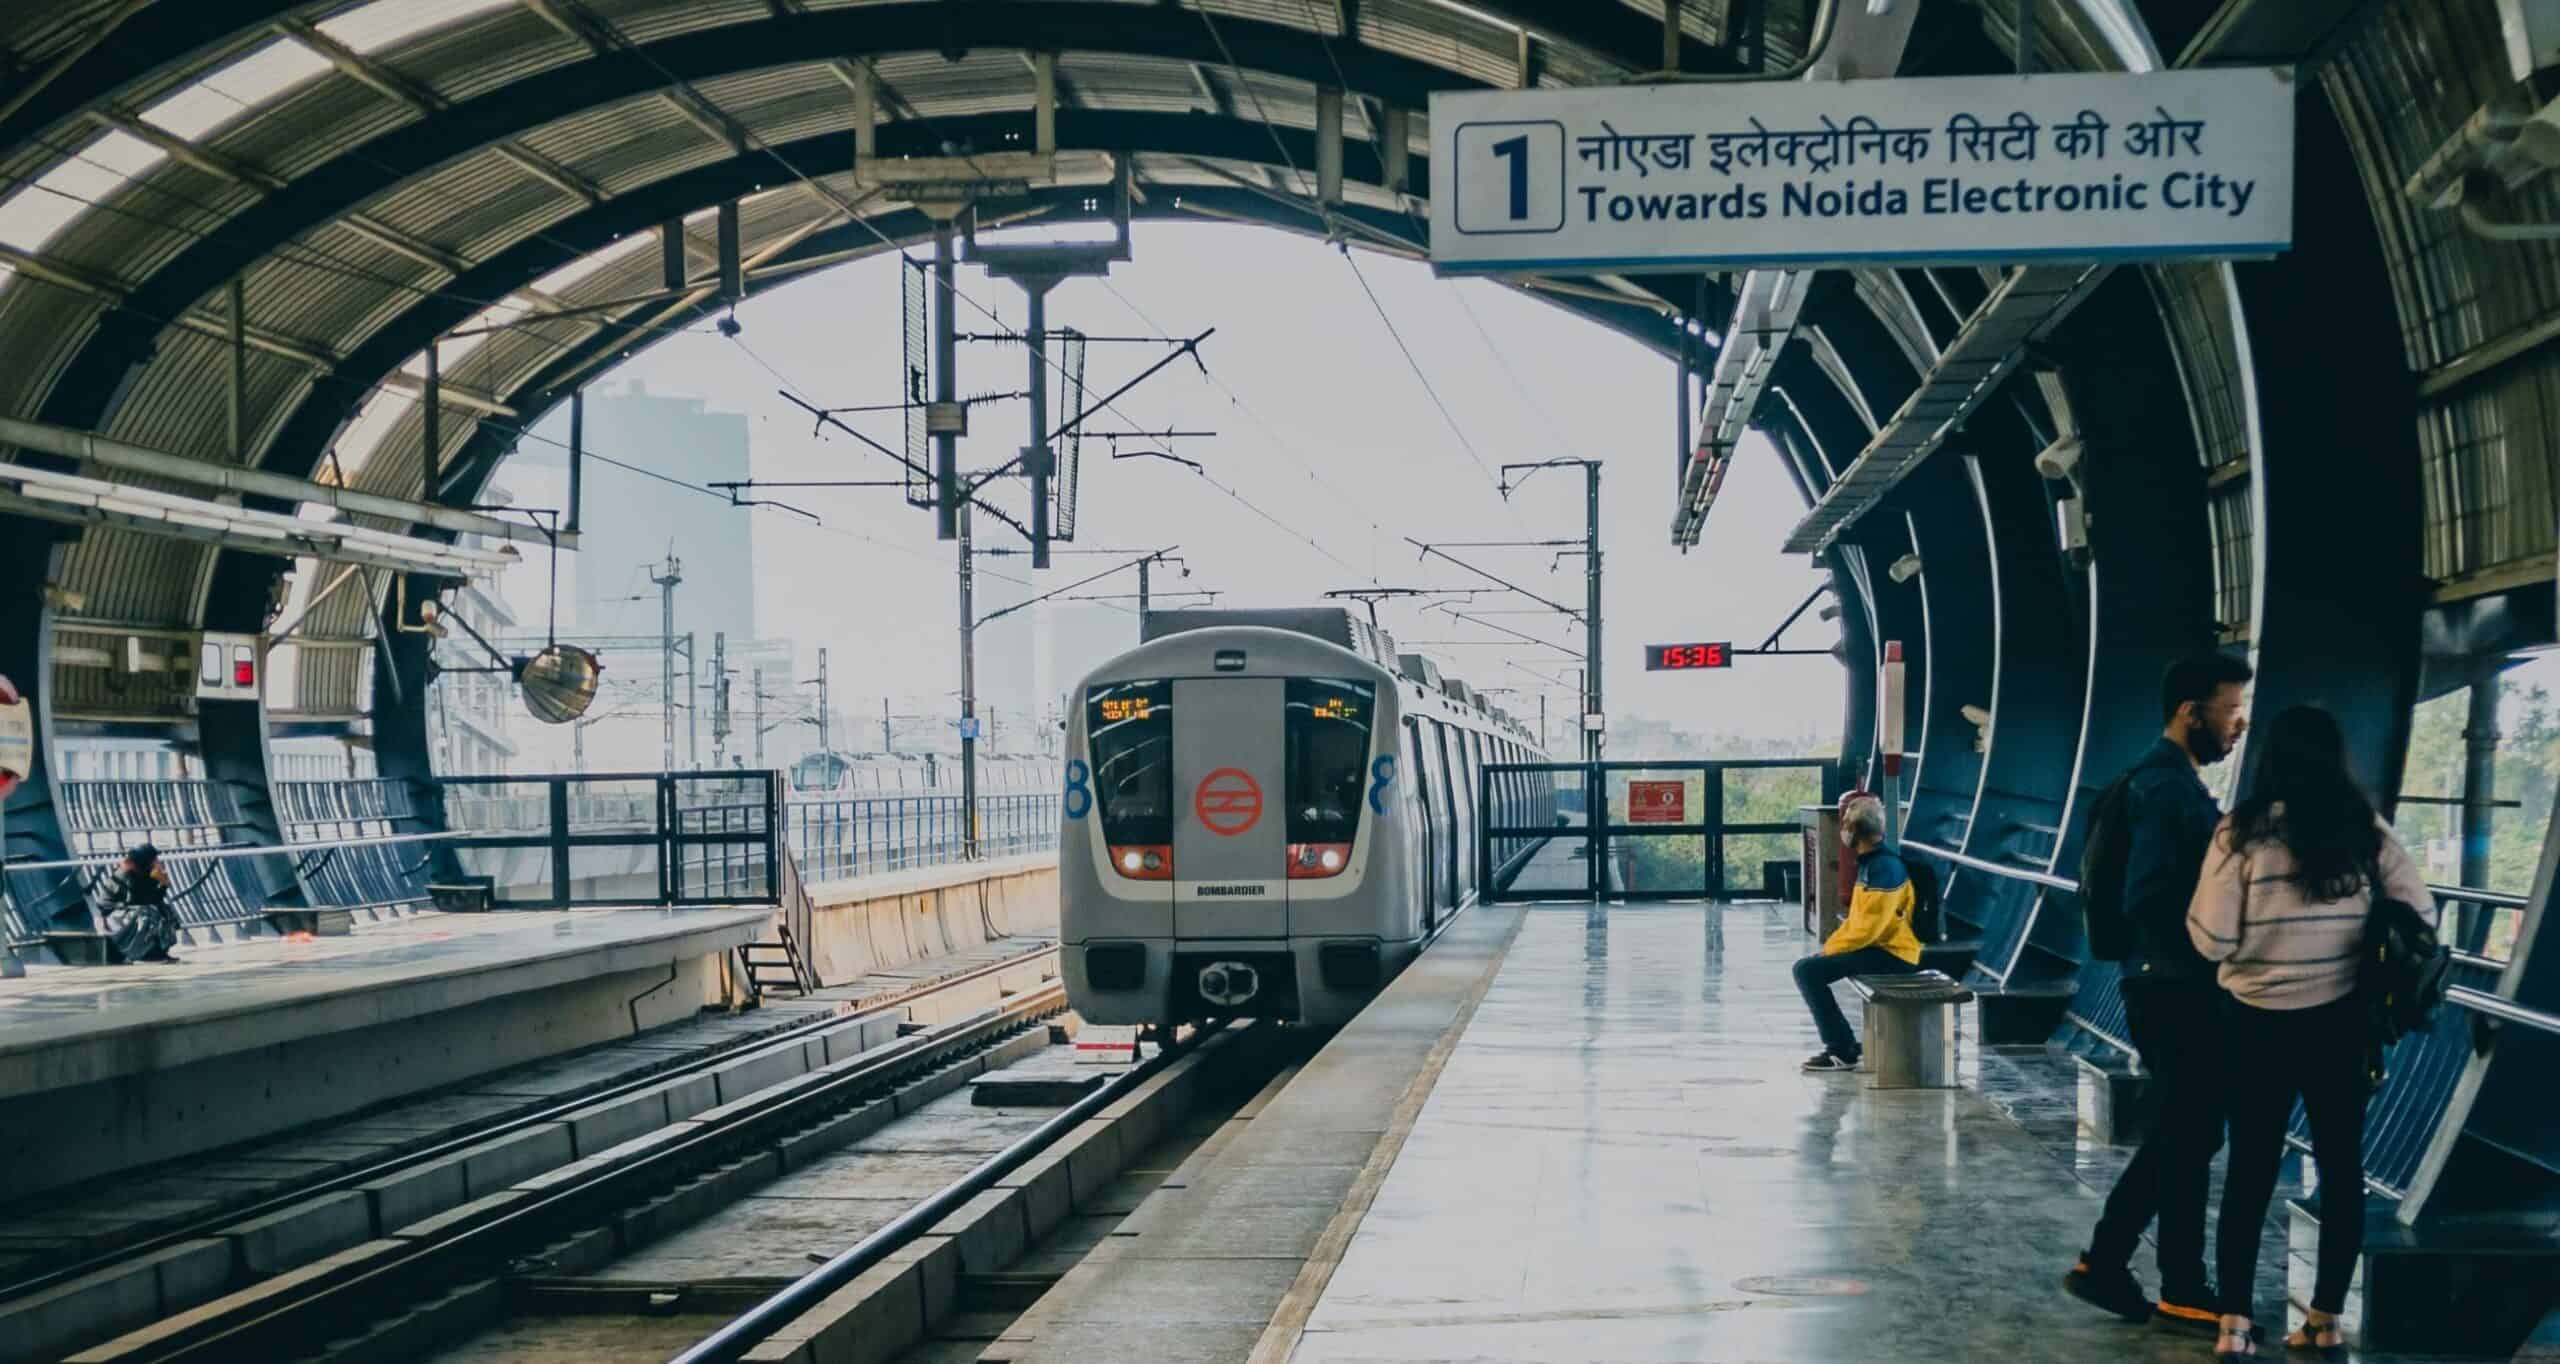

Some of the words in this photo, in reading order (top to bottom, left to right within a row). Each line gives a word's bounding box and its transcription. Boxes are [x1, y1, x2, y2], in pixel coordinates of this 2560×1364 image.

[1576, 120, 1696, 178] नोएडा
[1707, 114, 1932, 176] इलेक्ट्रोनिक
[1946, 111, 2040, 163] सिटी
[2052, 109, 2110, 160] की
[2124, 105, 2206, 158] ओर
[1492, 134, 1529, 221] 1
[1577, 183, 1768, 222] Towards
[1782, 179, 1909, 217] Noida
[1923, 173, 2148, 215] Electronic
[2161, 171, 2256, 217] City
[1663, 645, 1723, 668] 15:36
[1197, 885, 1265, 897] BOMBARDIER
